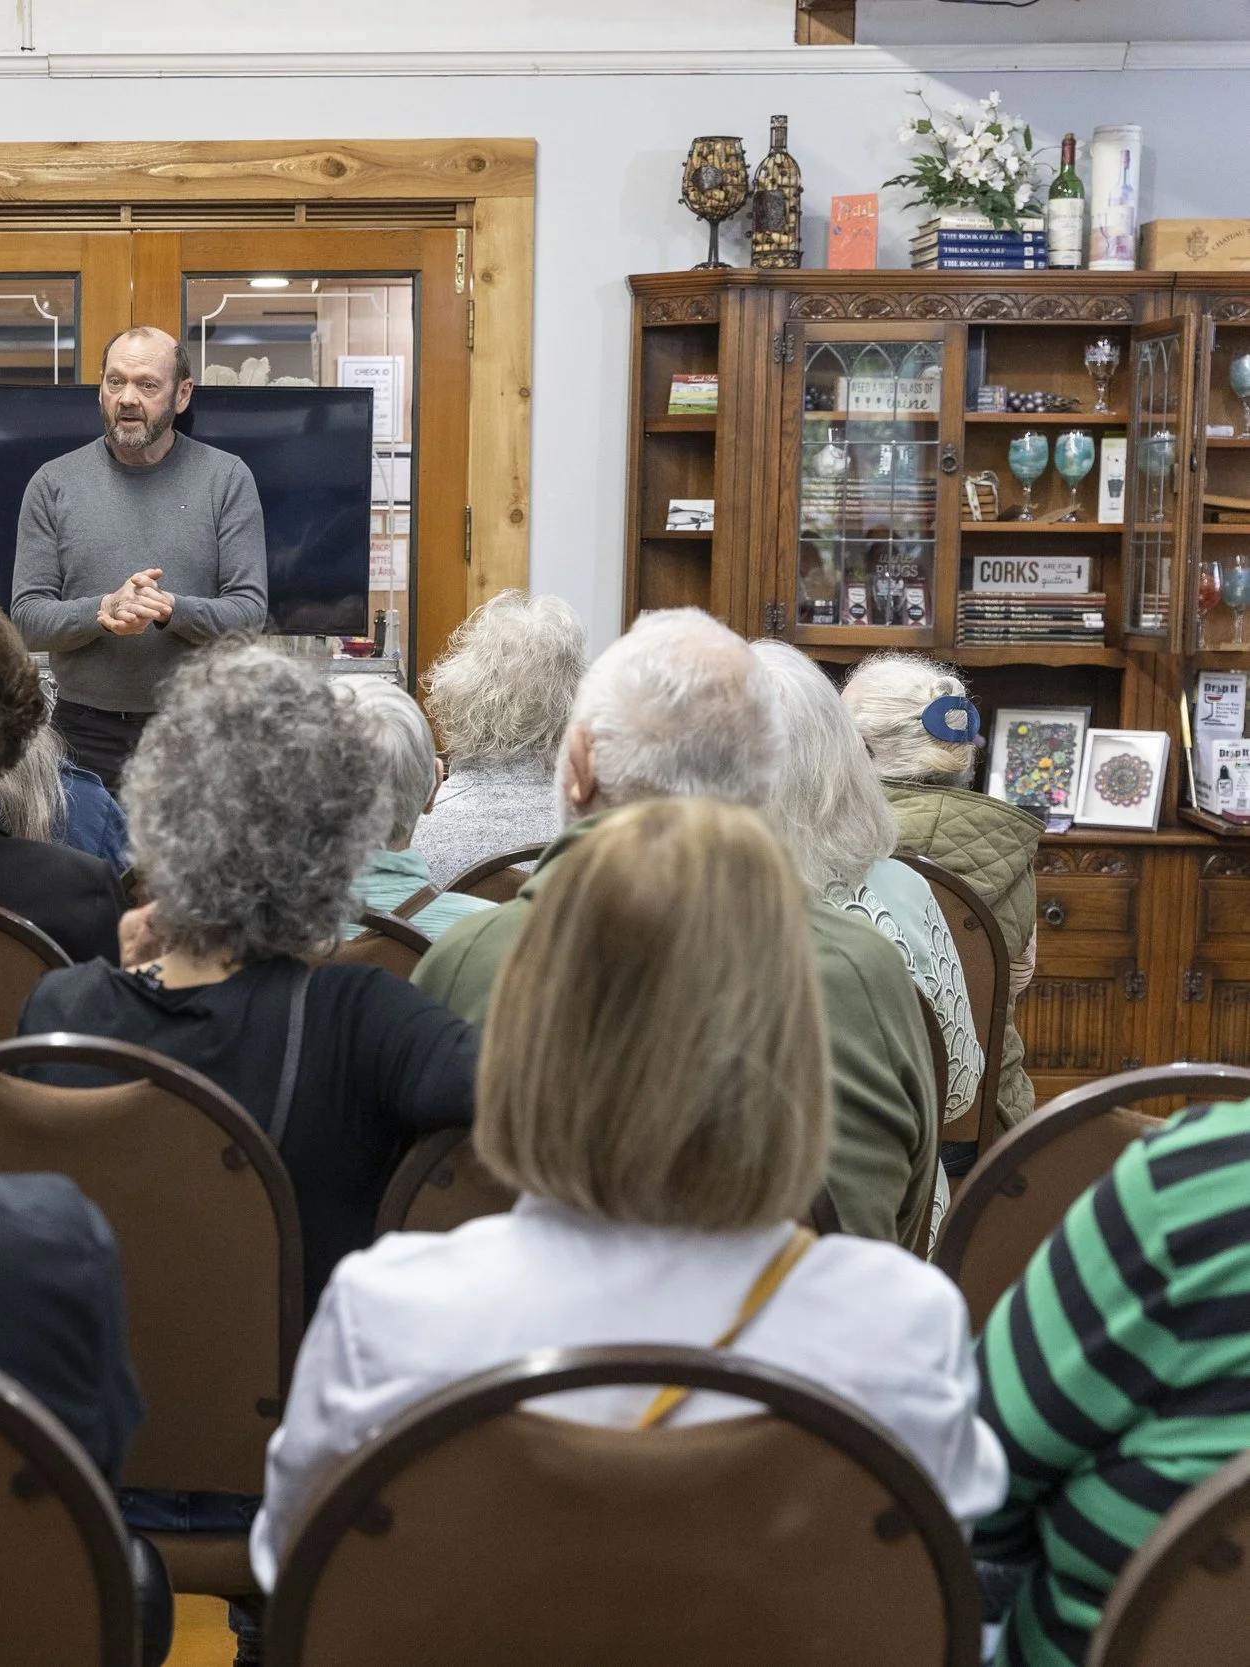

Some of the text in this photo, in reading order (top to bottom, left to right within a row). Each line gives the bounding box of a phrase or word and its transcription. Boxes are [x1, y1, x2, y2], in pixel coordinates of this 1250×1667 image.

[354, 368, 389, 376] CHECK ID
[851, 382, 871, 393] NEED
[872, 382, 878, 393] A
[900, 383, 923, 394] GLASS
[925, 383, 933, 394] OF
[886, 394, 930, 410] wine
[980, 560, 1040, 583] CORKS
